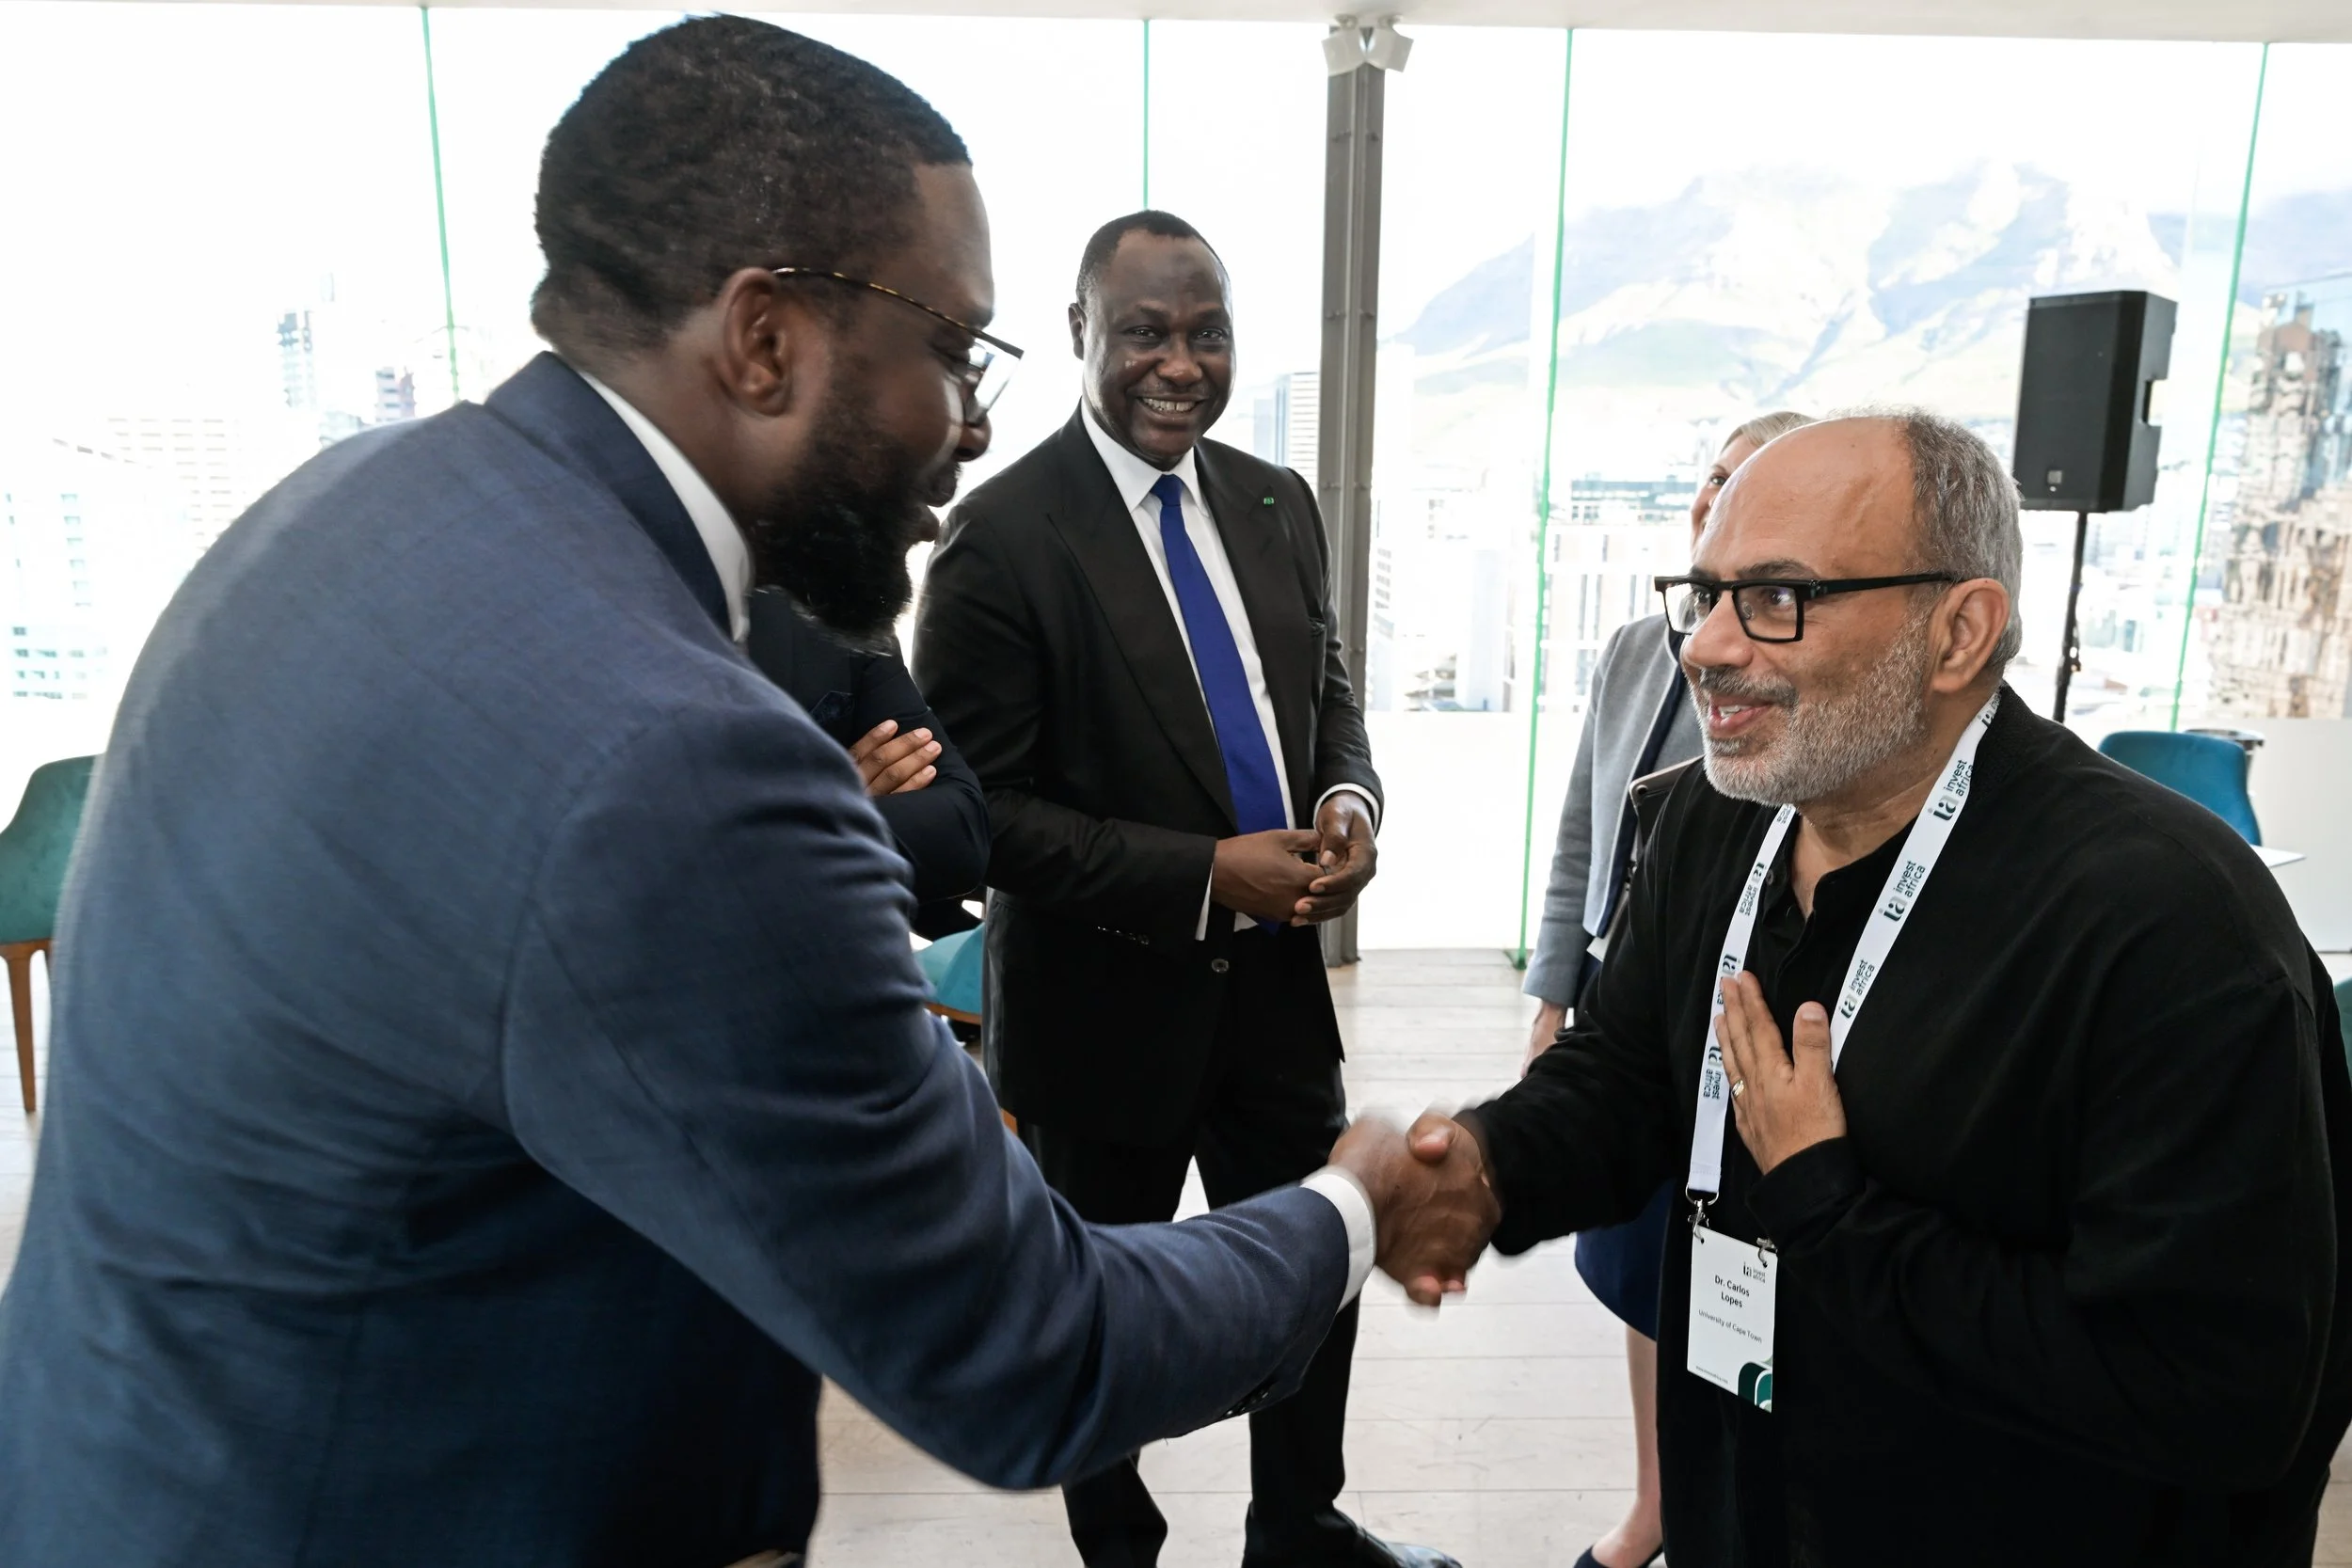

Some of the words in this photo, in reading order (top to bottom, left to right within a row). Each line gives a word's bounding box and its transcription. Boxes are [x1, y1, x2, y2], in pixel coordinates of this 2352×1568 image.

[1944, 759, 1967, 792] invest
[1955, 765, 1974, 797] africa
[1893, 861, 1916, 894] invest
[1904, 865, 1926, 897] africa
[1740, 885, 1753, 913] africa
[1849, 959, 1867, 990] invest
[1856, 964, 1875, 996] africa
[1703, 1069, 1713, 1098] africa
[1712, 1070, 1723, 1100] invest
[1714, 1275, 1725, 1287] Dr.
[1726, 1279, 1750, 1297] Carlos
[1721, 1291, 1742, 1308] Lopes
[1698, 1308, 1724, 1327] University
[1732, 1323, 1746, 1336] Cape
[1747, 1329, 1762, 1343] Town
